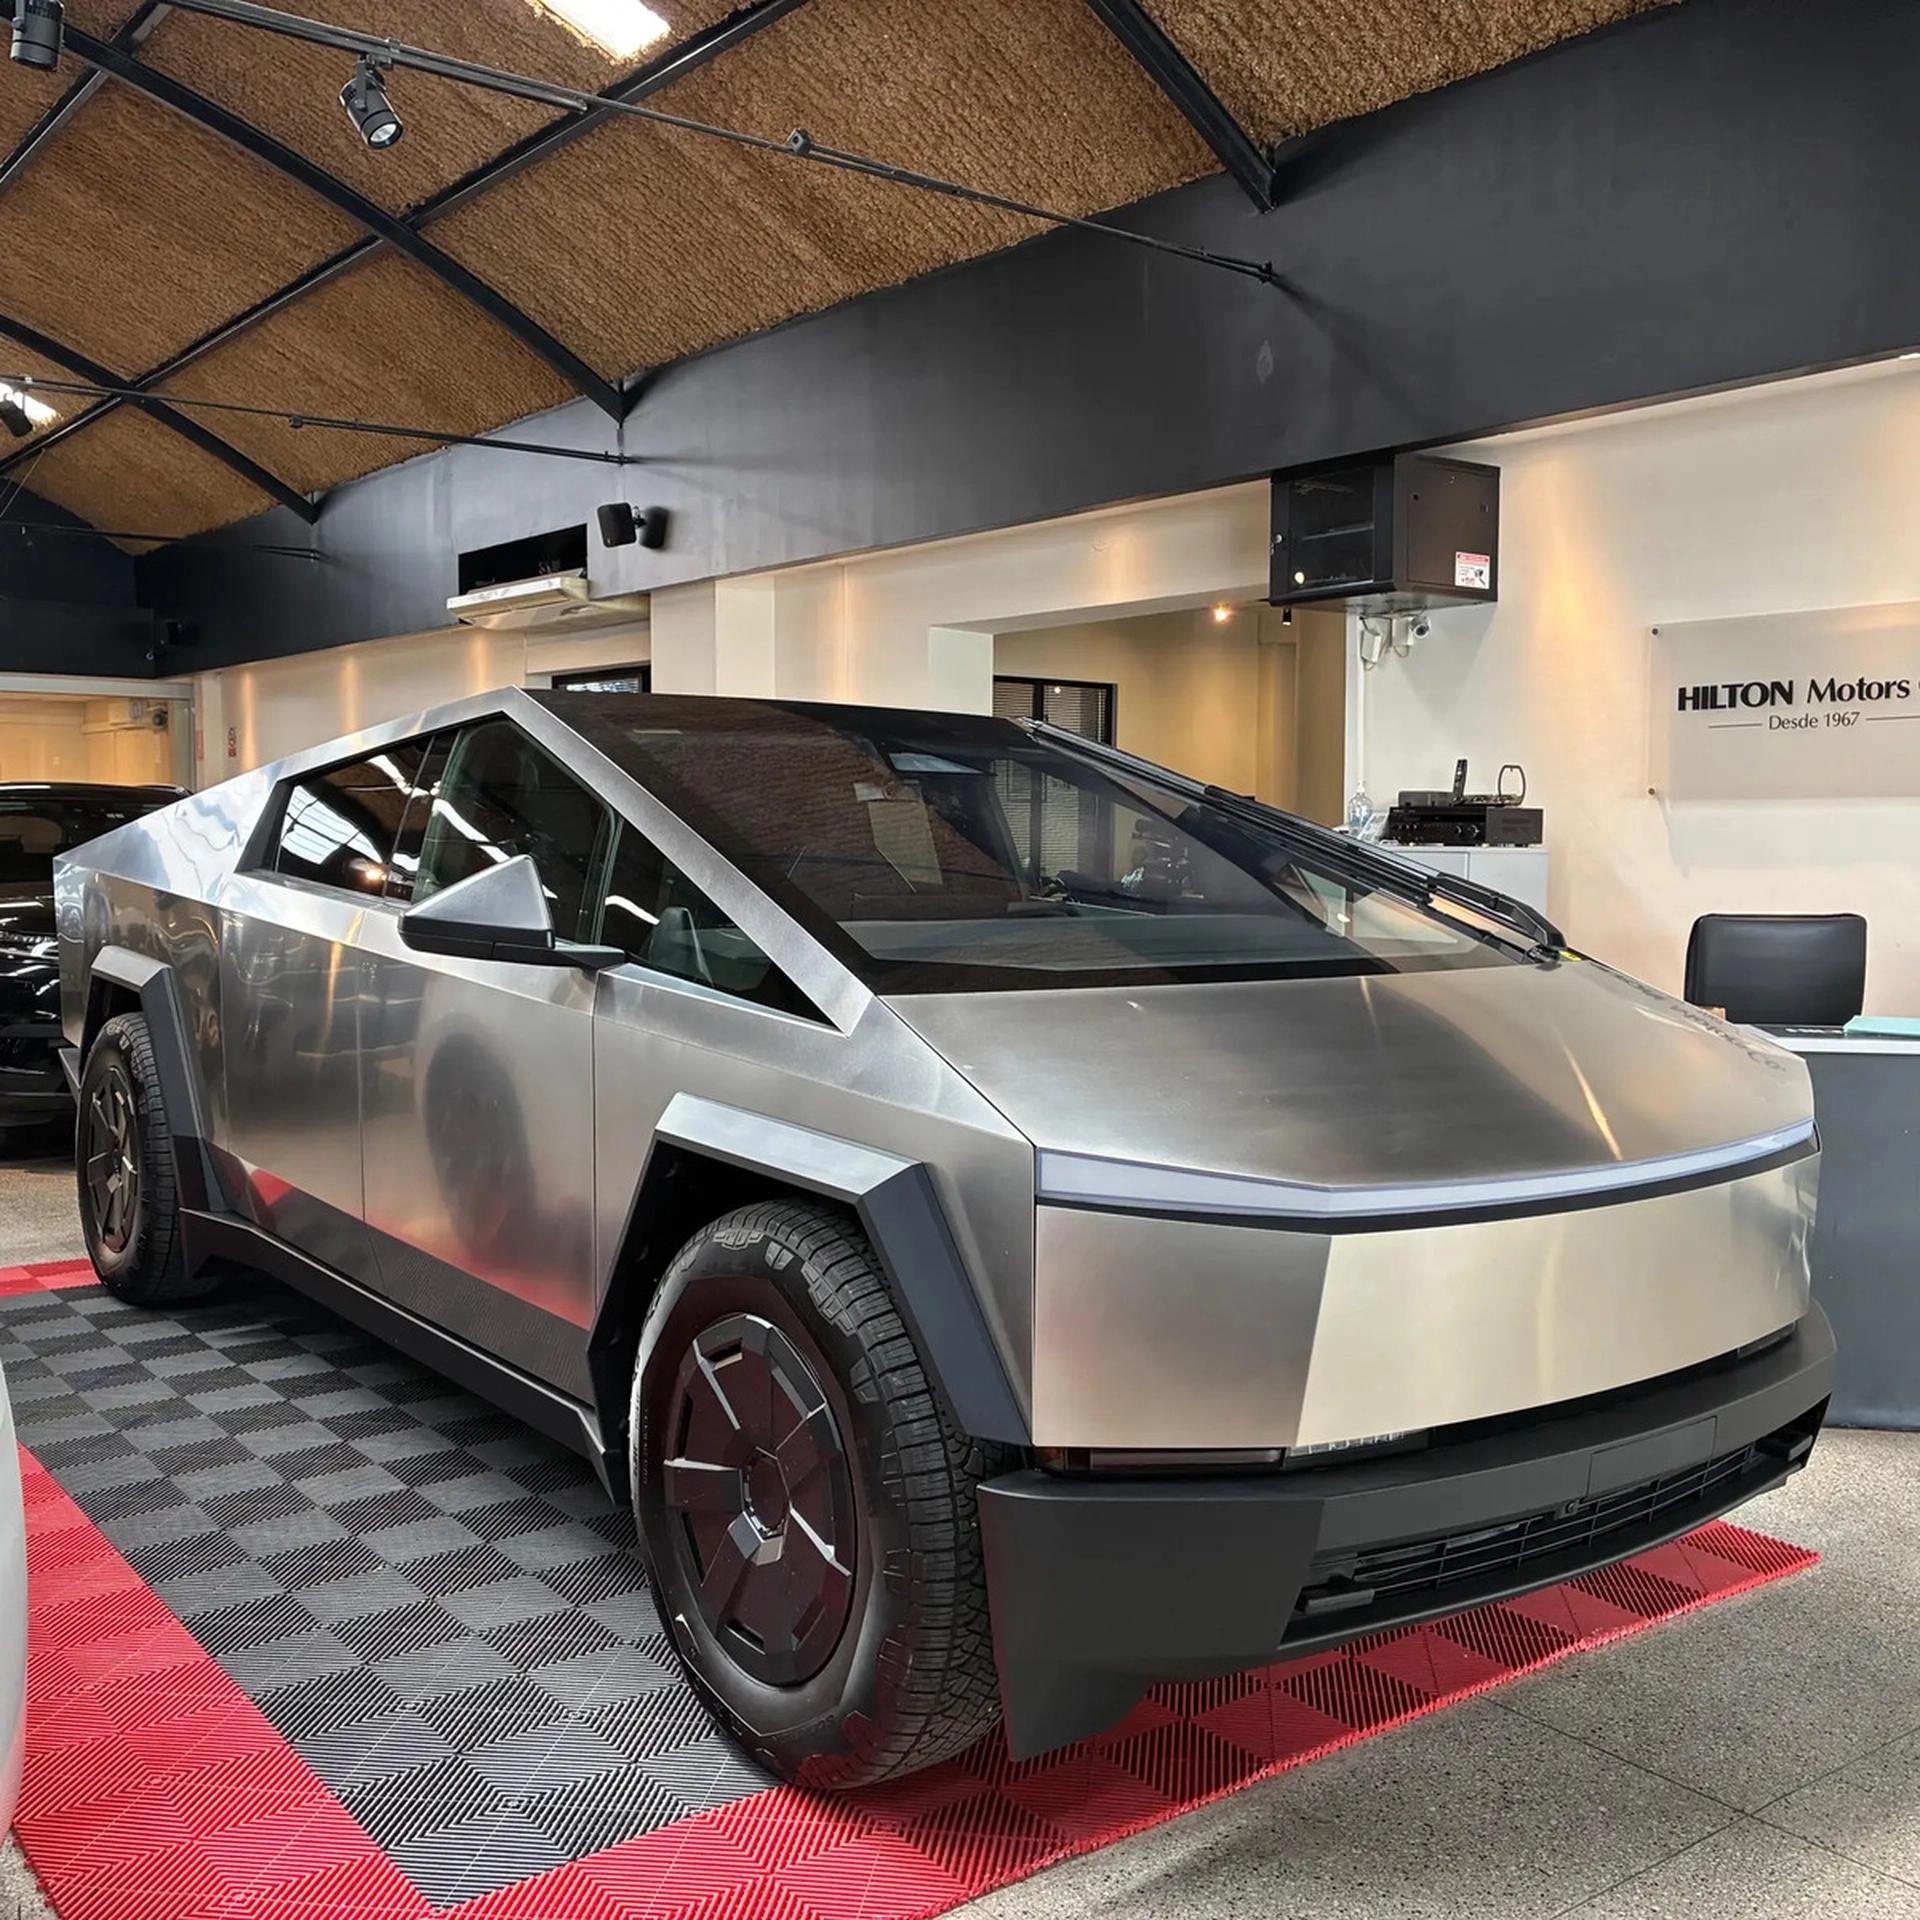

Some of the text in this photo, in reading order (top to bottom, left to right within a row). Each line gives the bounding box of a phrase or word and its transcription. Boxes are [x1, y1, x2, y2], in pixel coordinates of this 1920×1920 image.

[1677, 676, 1910, 711] HILTON Motors
[1769, 712, 1860, 730] Desde 1967
